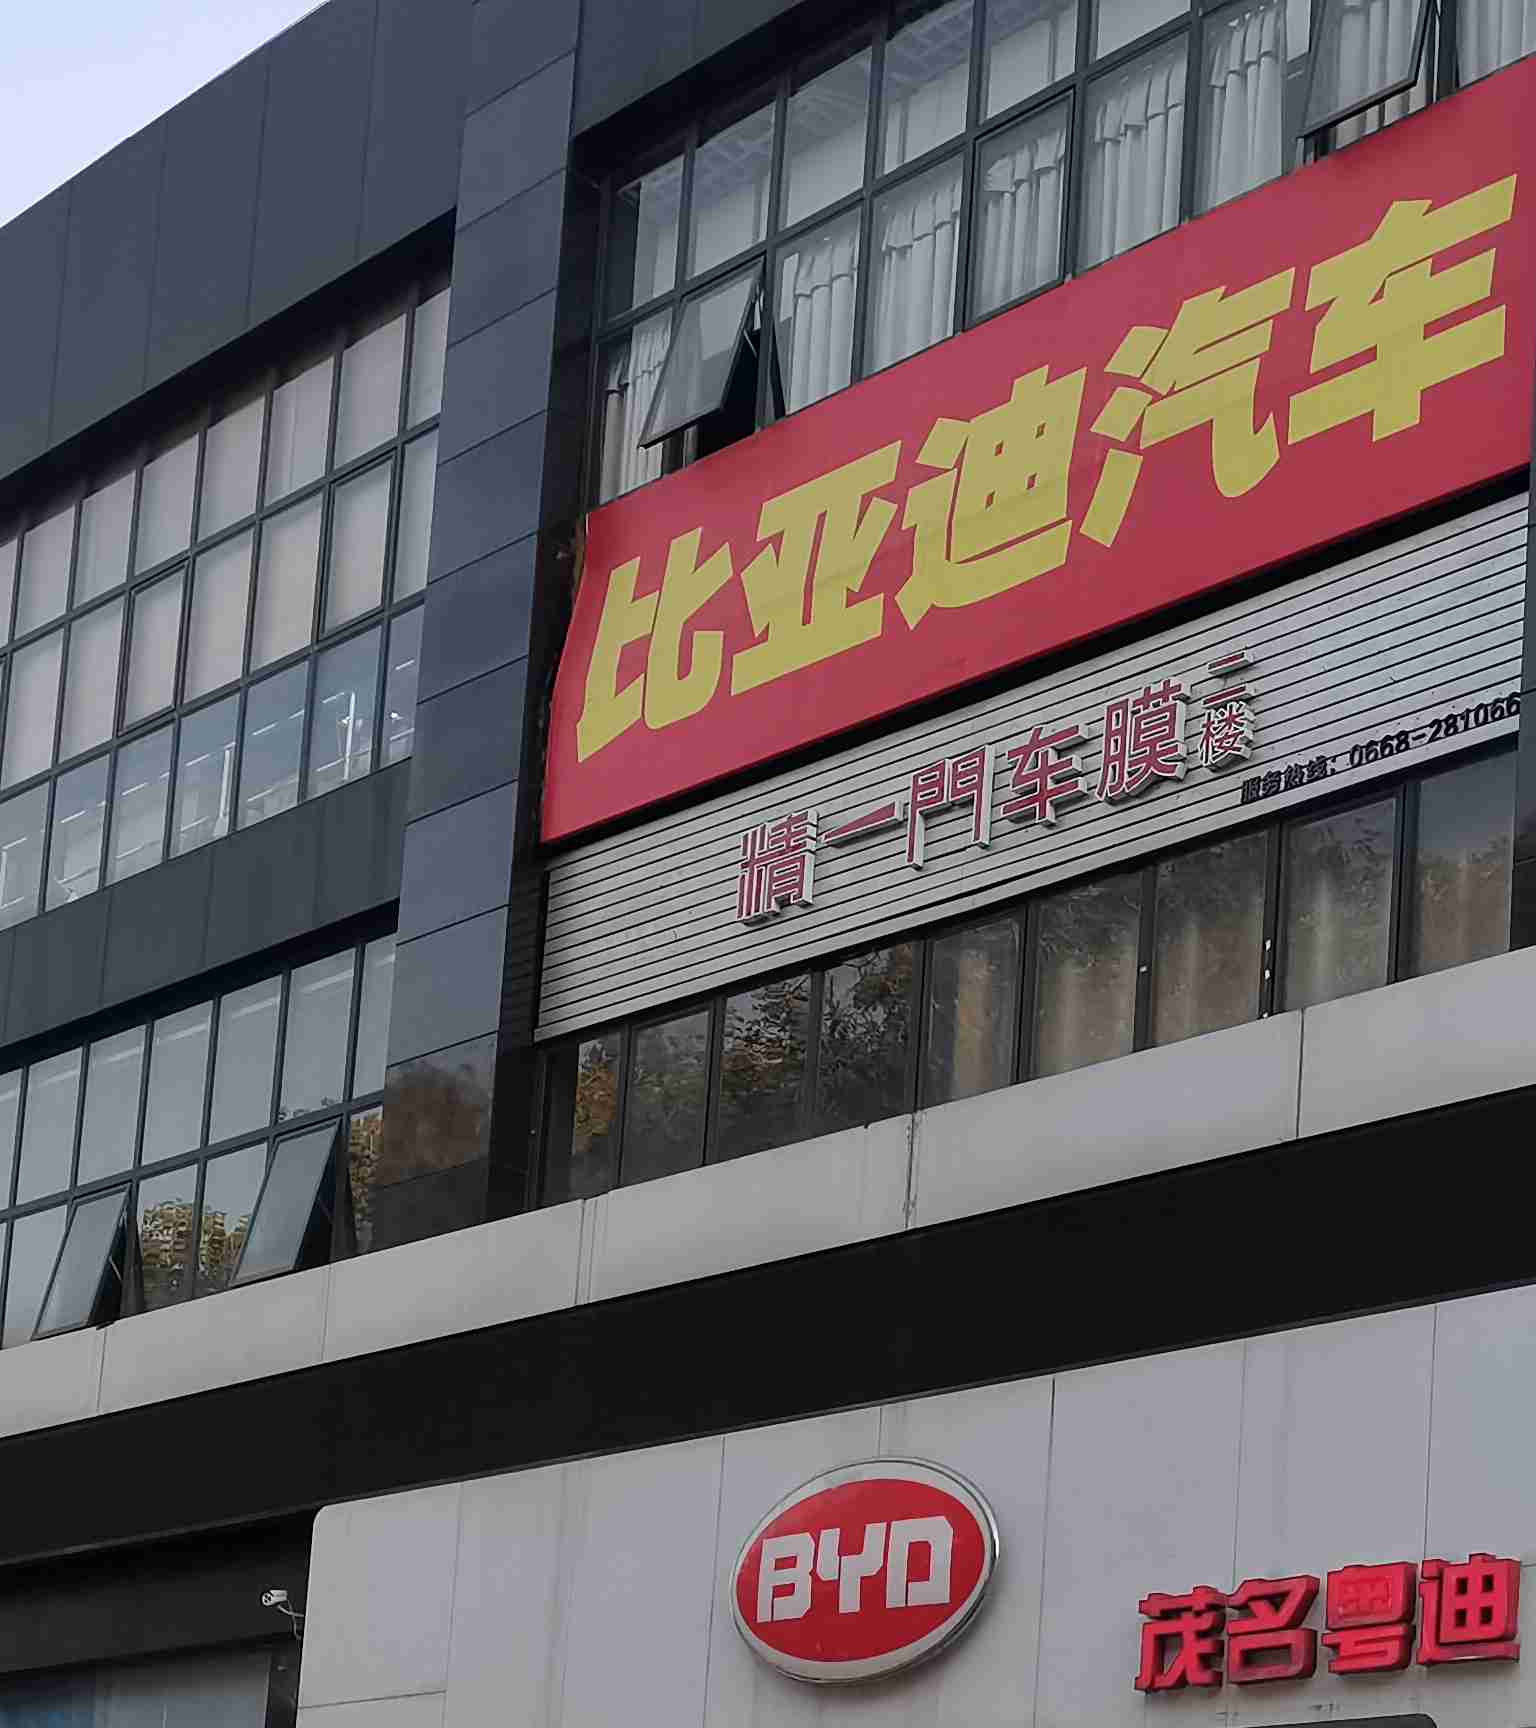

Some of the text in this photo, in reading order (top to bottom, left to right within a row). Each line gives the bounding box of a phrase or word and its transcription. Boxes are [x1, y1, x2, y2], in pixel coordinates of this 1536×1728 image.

[576, 174, 1517, 764] 比亚迪汽车
[756, 1516, 954, 1625] BYD
[1134, 1552, 1520, 1693] 茂名粤迪
